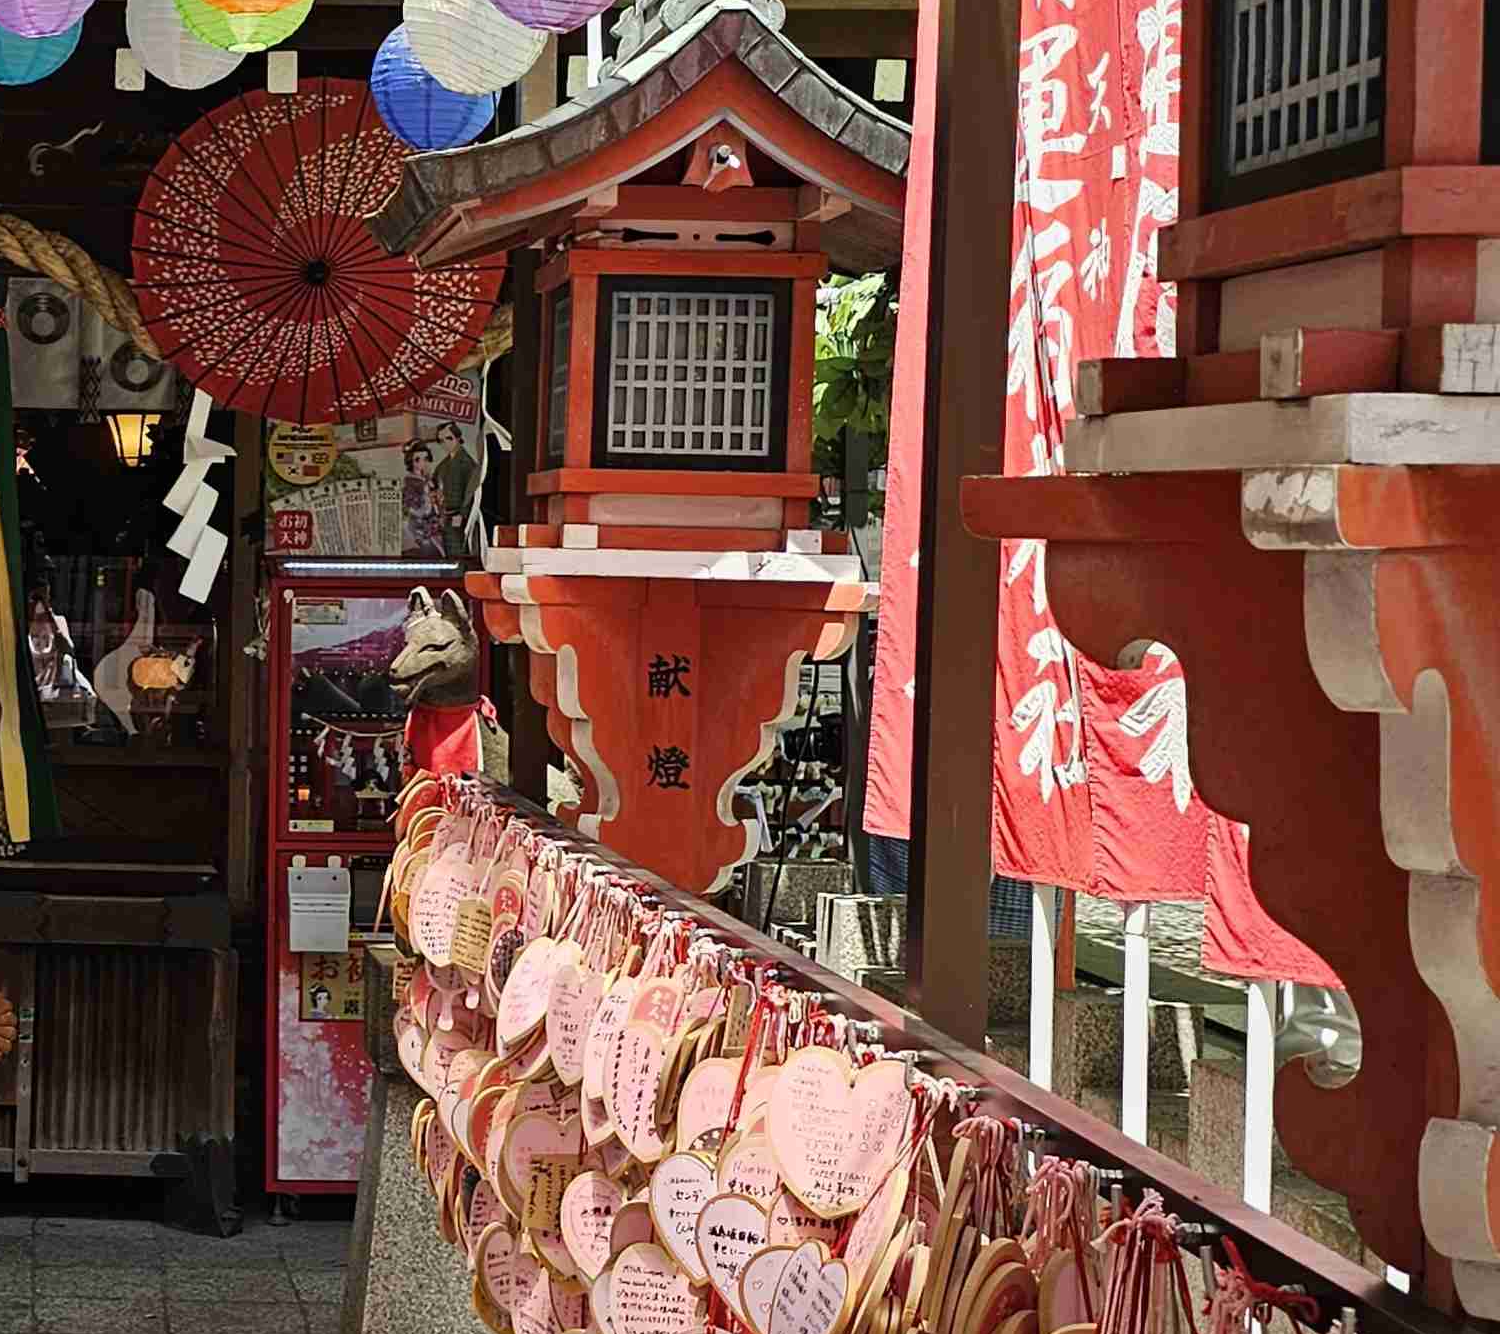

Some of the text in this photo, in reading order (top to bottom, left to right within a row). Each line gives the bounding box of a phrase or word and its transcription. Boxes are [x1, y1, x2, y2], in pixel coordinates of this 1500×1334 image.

[407, 395, 475, 422] OMIKUJI
[278, 514, 308, 531] お初
[278, 531, 308, 548] 天神
[646, 652, 693, 791] 献燈
